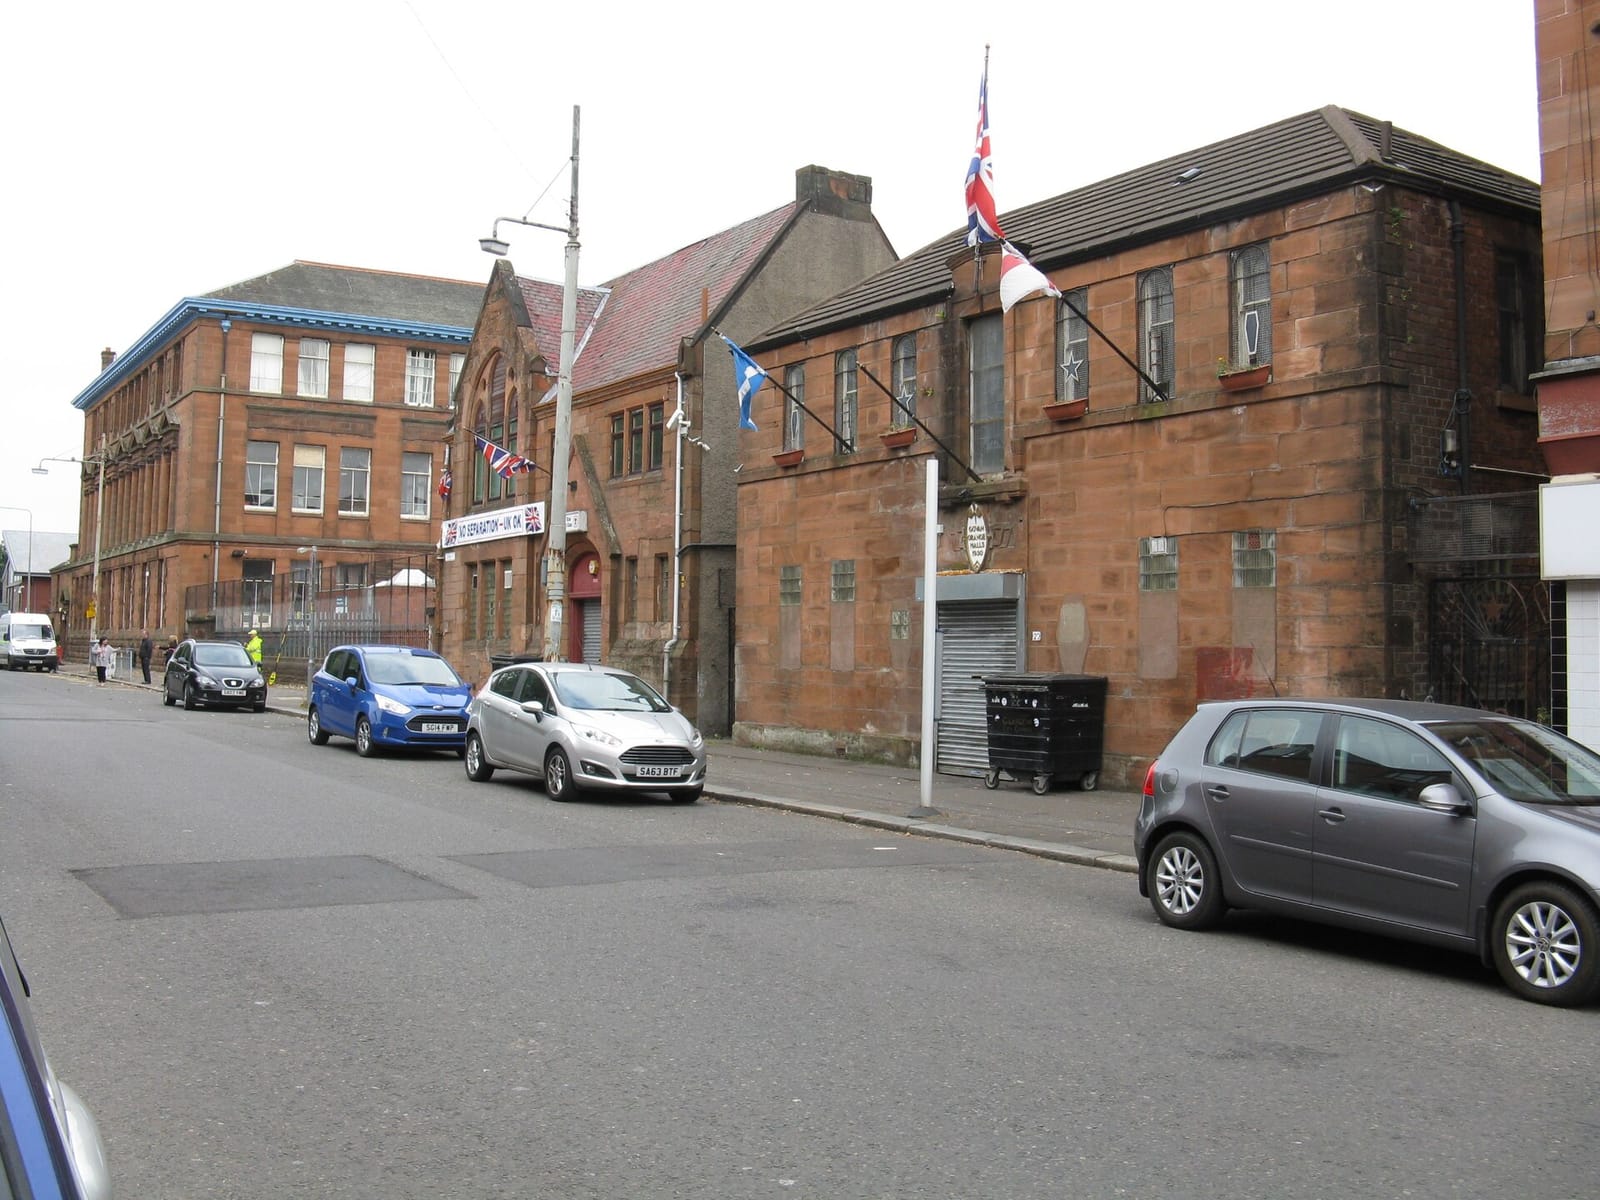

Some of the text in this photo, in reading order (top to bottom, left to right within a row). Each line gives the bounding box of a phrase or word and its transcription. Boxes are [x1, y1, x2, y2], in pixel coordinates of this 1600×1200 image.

[458, 525, 466, 538] NO
[467, 518, 499, 537] SEPARATION
[504, 516, 511, 530] UK
[513, 514, 522, 529] OK
[967, 533, 986, 541] ORANGE
[970, 541, 985, 549] HALLS
[640, 767, 679, 776] SA63 BTF
